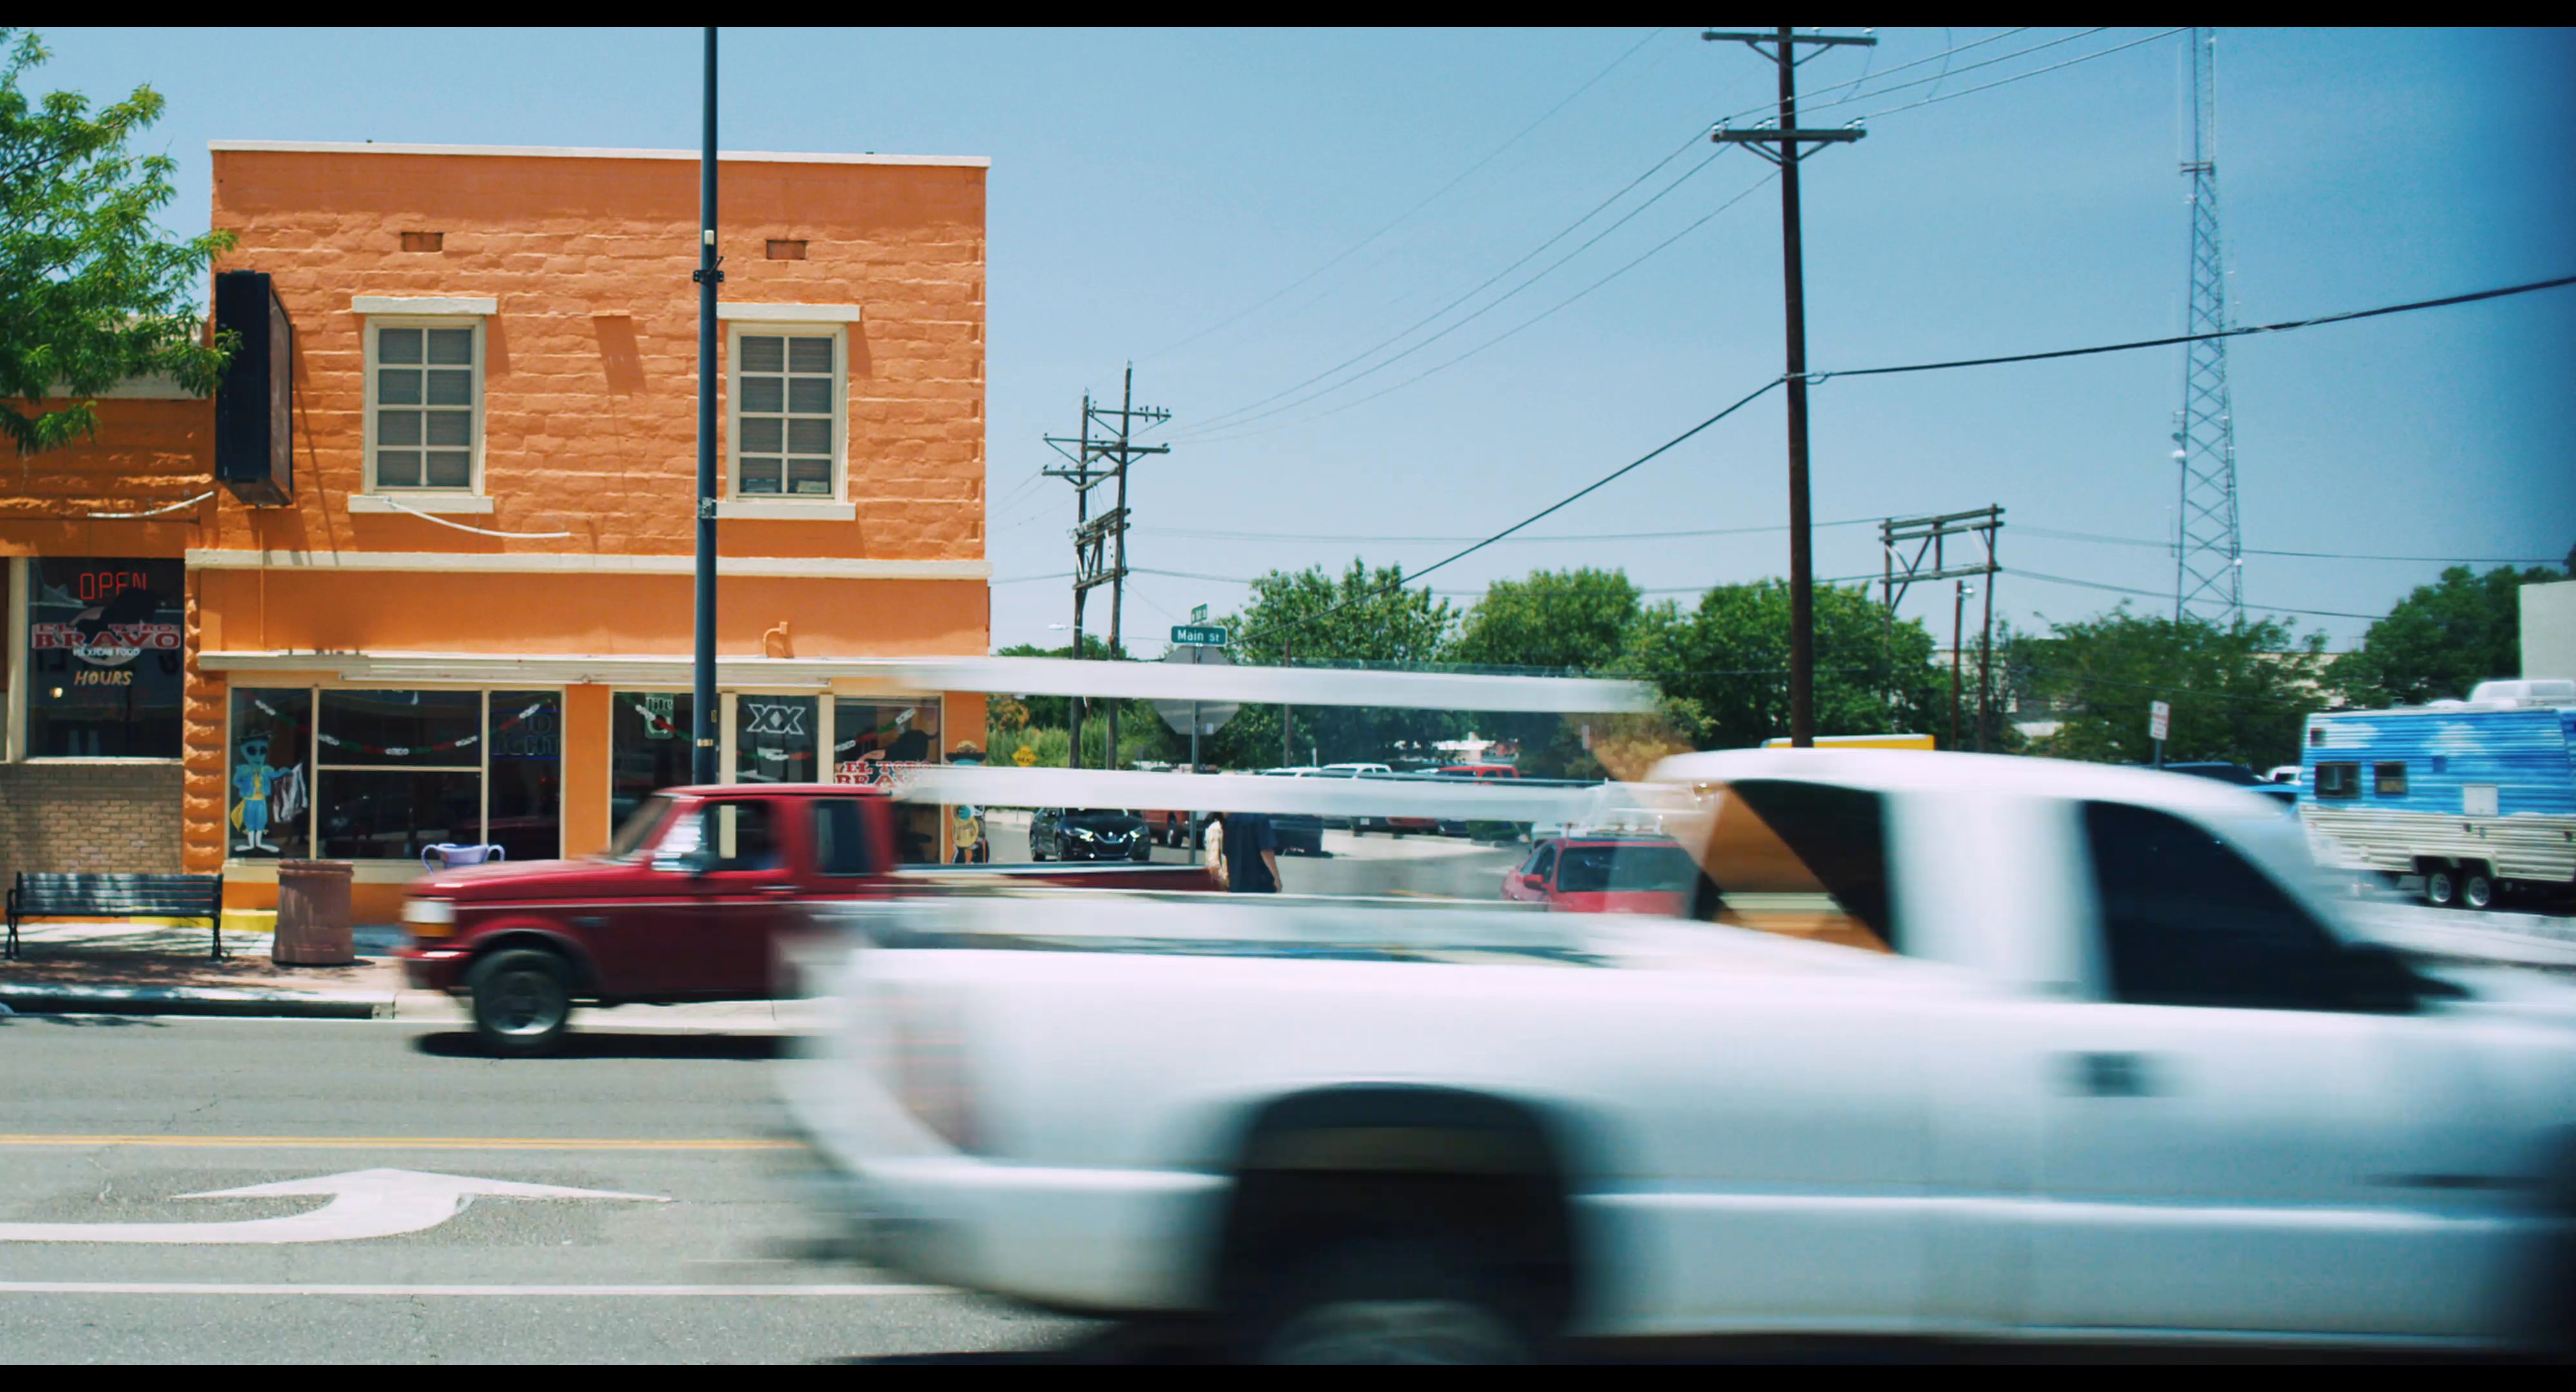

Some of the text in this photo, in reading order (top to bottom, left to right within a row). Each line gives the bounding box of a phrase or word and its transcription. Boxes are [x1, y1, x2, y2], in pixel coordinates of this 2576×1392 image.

[80, 572, 147, 599] OPEN
[35, 632, 179, 648] BRAVO
[1177, 629, 1204, 641] Main
[73, 670, 133, 686] HOURS
[746, 703, 806, 735] XX
[844, 762, 873, 773] EL
